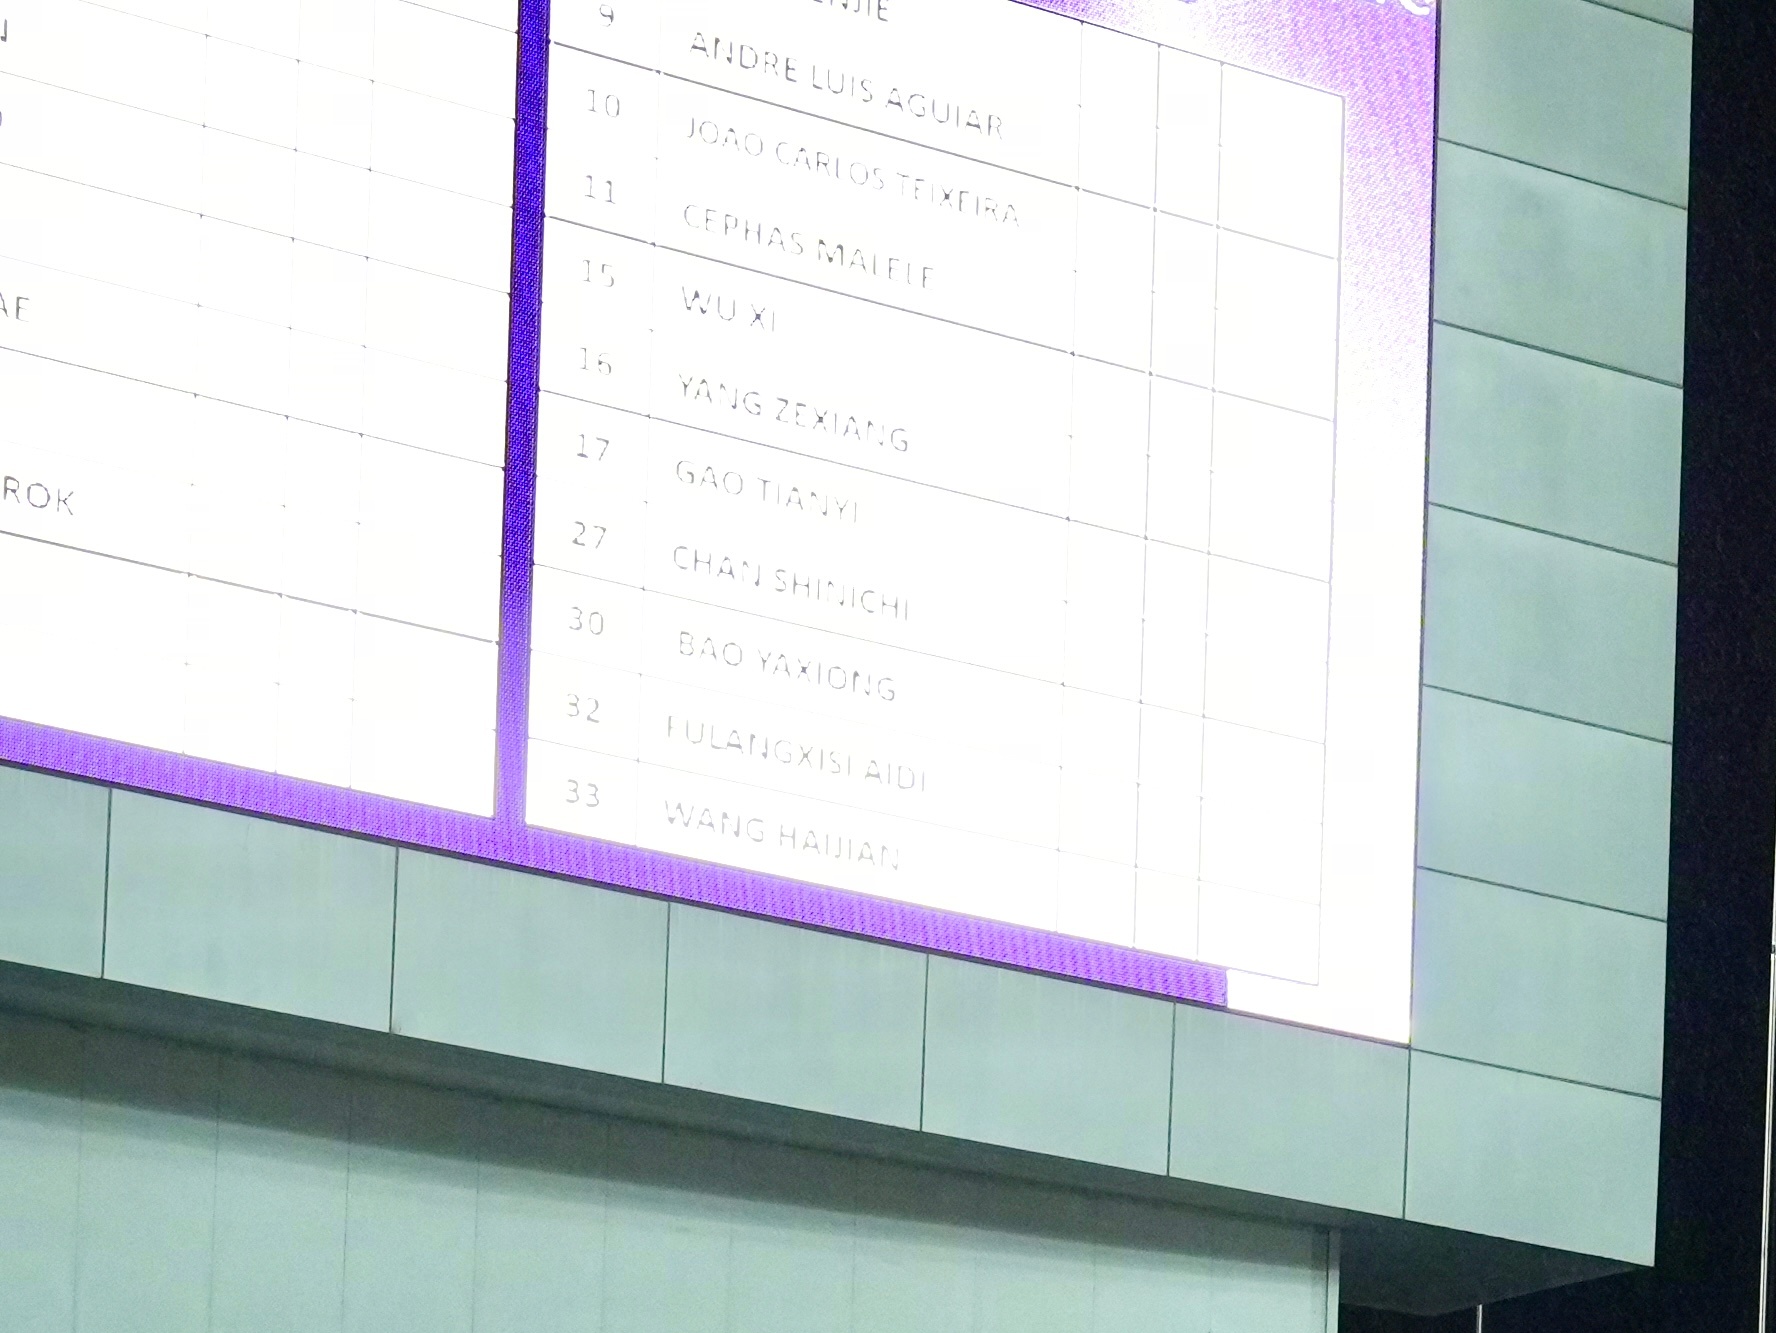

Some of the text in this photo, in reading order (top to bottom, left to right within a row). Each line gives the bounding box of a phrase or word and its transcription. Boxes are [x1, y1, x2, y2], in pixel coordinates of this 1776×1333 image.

[690, 31, 798, 83] ANDRE
[811, 66, 873, 103] LUIS
[885, 87, 1004, 140] AGUIAR
[587, 89, 1020, 228] 10 JOAO CARLOS TEIXEIRA
[584, 175, 616, 205] 11
[684, 204, 804, 256] CEPHAS
[582, 259, 775, 332] 15 WU XI
[580, 347, 908, 453] 16 YANG ZEXIANG
[576, 434, 858, 523] 17 GAO TIANYI
[572, 521, 909, 621] 27 CHAN SHINICHI
[568, 607, 896, 702] 30 BAO YAXIONG
[566, 694, 925, 792] 32 FULANGXISI AIDI
[565, 779, 900, 871] 33 WANG HAIJIAN
